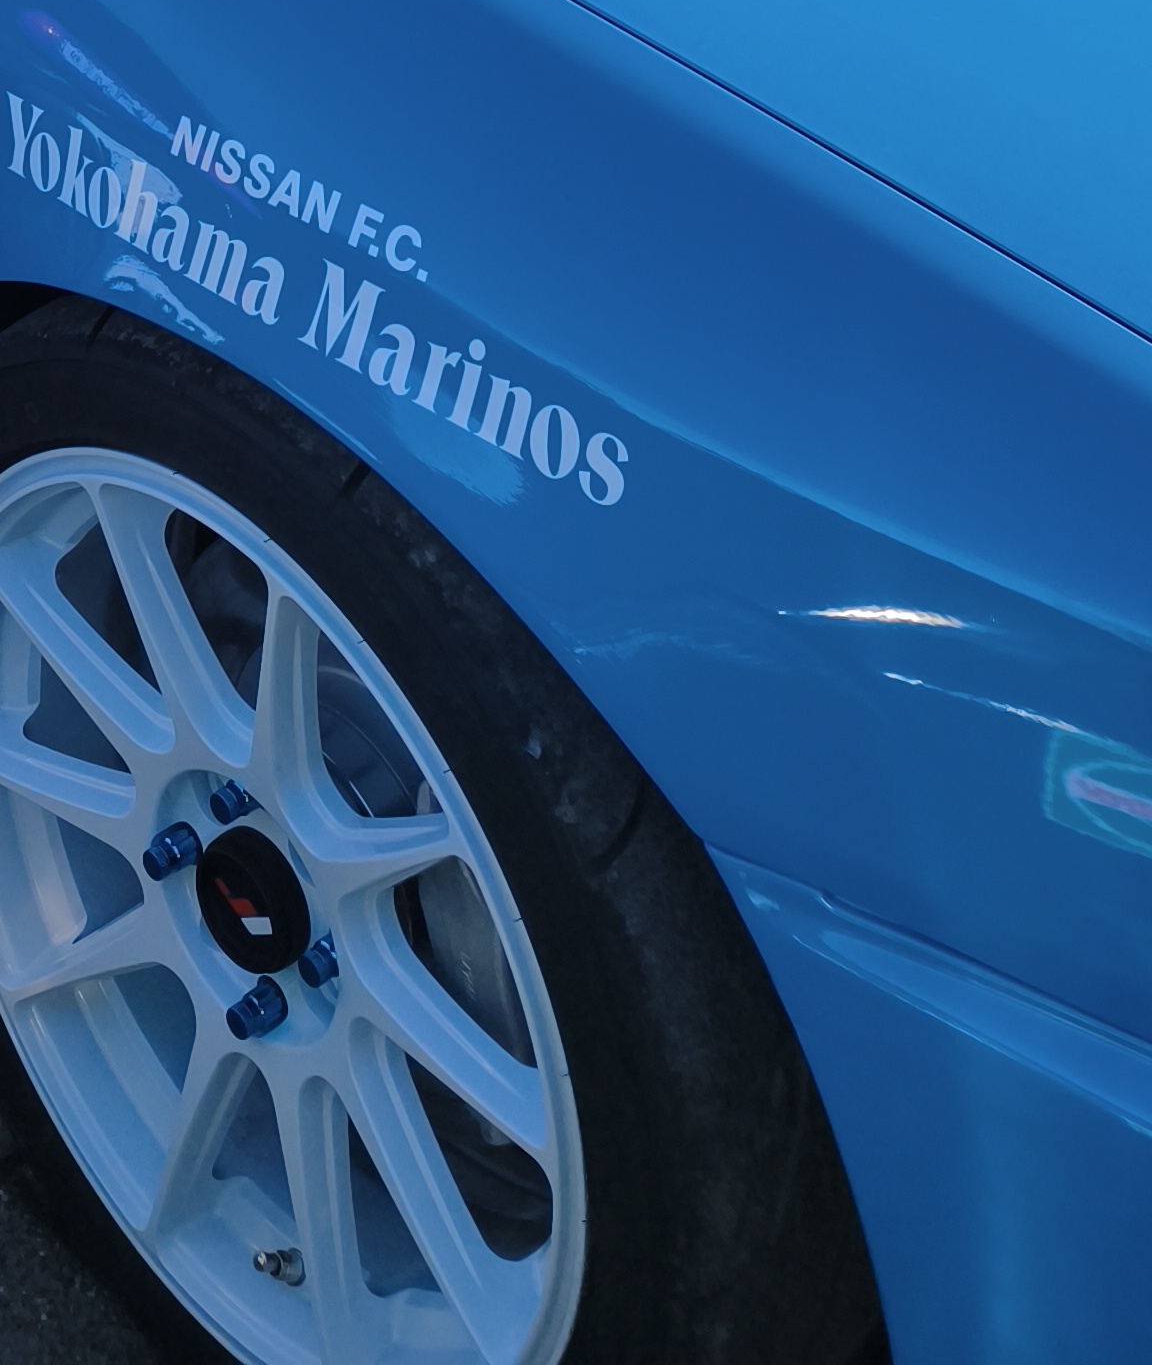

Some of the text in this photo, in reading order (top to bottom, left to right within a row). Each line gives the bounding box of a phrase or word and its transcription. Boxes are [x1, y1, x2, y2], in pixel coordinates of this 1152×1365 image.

[6, 90, 629, 506] Yokohama Marinos
[170, 115, 429, 283] NISSAN F.C.
